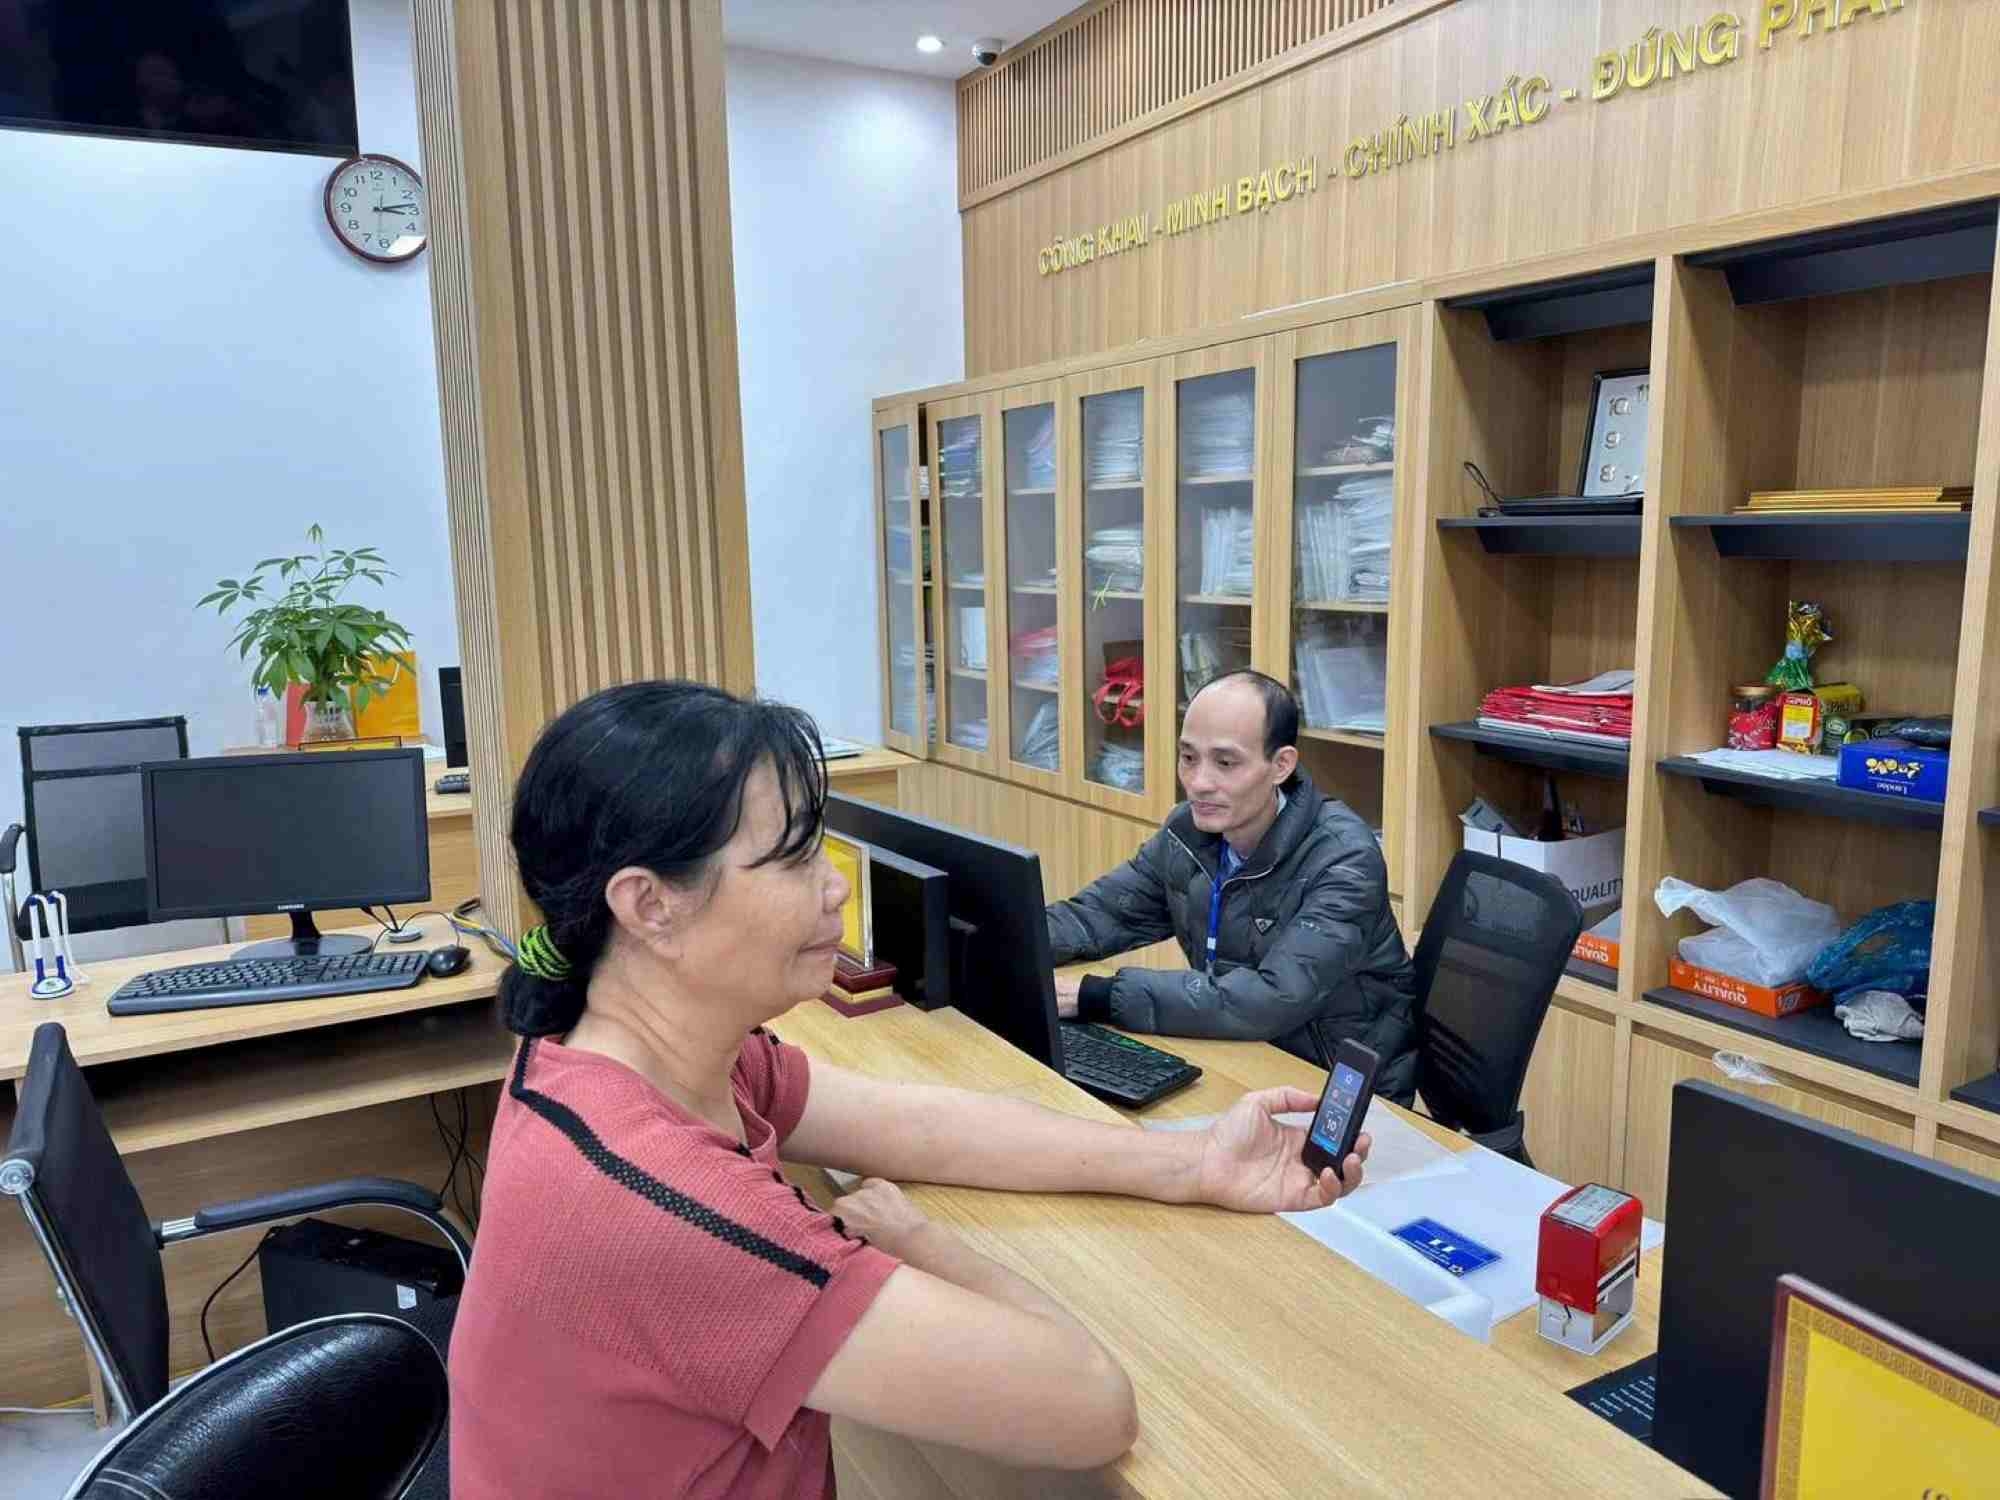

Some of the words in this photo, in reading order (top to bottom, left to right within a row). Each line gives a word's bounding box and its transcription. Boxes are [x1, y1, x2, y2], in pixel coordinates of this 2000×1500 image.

[1039, 233, 1094, 276] CÔNG
[1098, 211, 1149, 257] KHAI
[1166, 183, 1231, 236] MINH
[1237, 154, 1318, 214] BẠCH
[1343, 106, 1456, 178] CHÍNH
[1465, 72, 1552, 143] XÁC
[1591, 12, 1742, 103] ĐÚNG
[1759, 0, 1904, 50] PH
[354, 175, 366, 185] 11
[370, 170, 383, 181] 12
[392, 176, 397, 186] 1
[343, 187, 357, 198] 10
[402, 190, 414, 200] 2
[340, 202, 352, 213] 9
[408, 205, 420, 216] 3
[348, 219, 360, 230] 8
[405, 222, 416, 232] 4
[362, 233, 372, 242] 7
[379, 239, 391, 249] 6
[1569, 878, 1623, 902] QUALIT
[1693, 981, 1748, 1005] QUALITY
